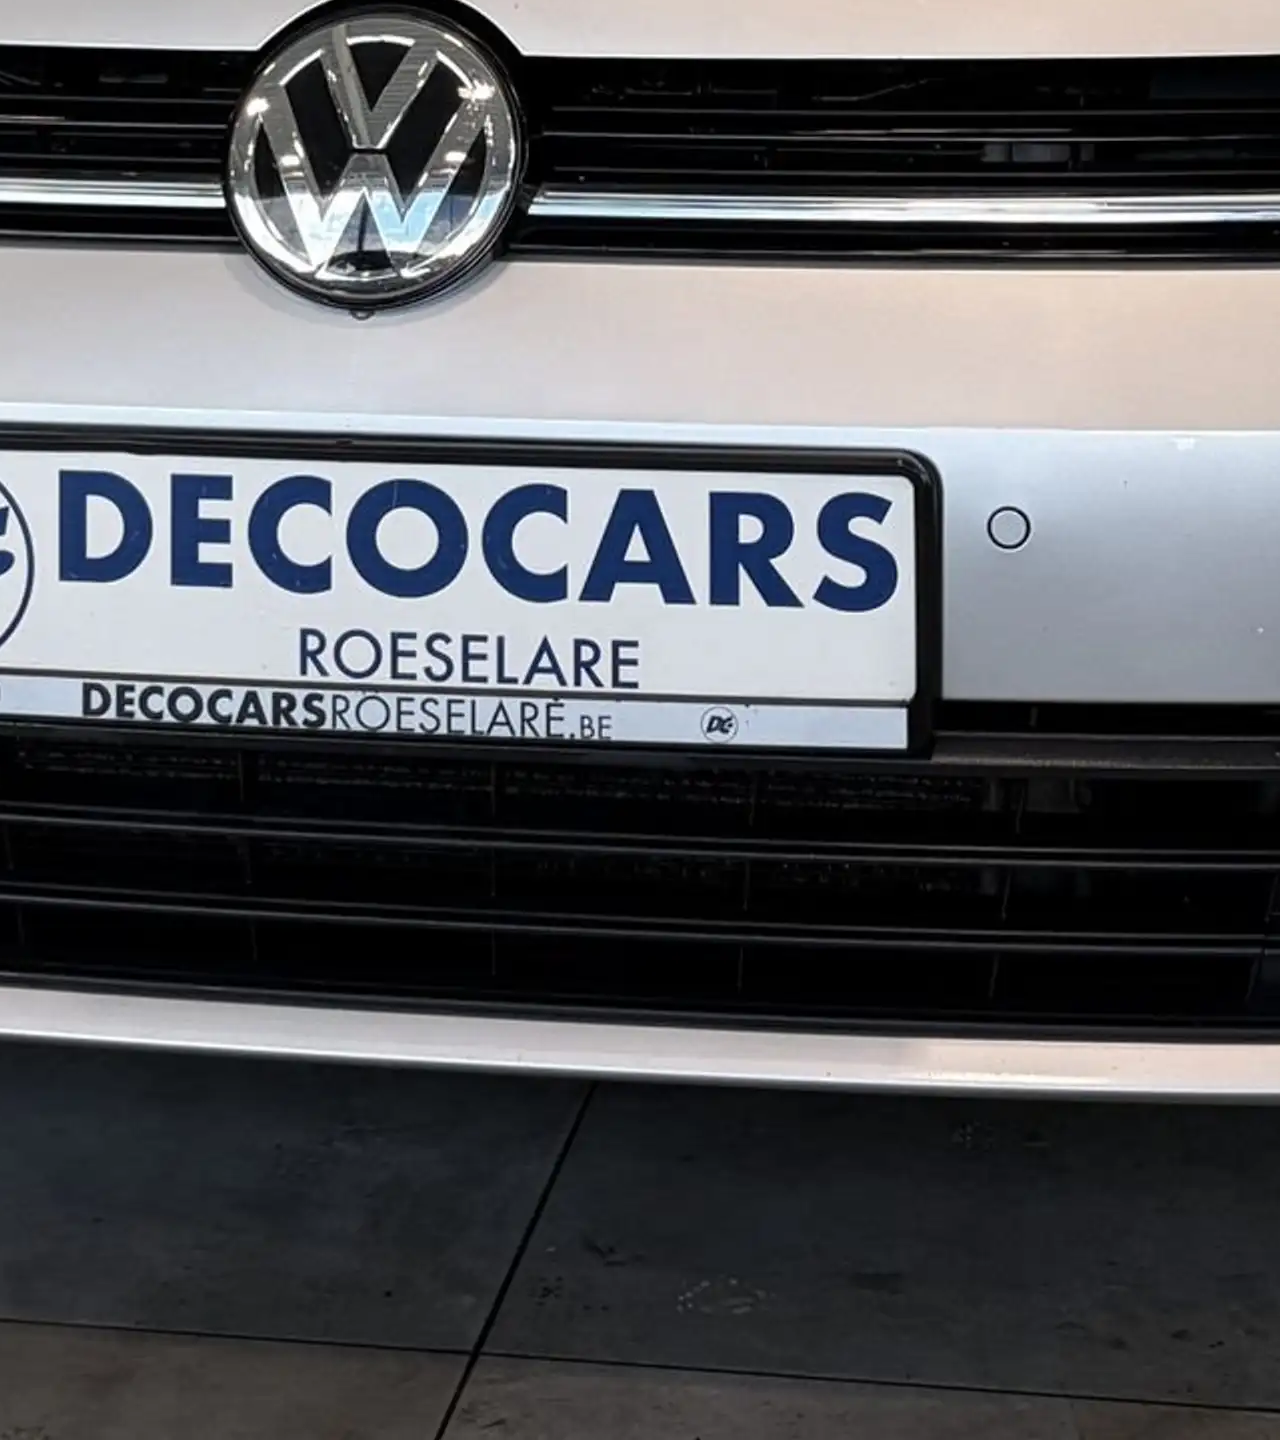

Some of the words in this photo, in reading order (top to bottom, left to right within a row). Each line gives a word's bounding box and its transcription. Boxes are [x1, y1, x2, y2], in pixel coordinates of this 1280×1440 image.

[245, 22, 496, 276] VW
[58, 469, 899, 613] DECOCARS
[298, 627, 640, 689] ROESELARE
